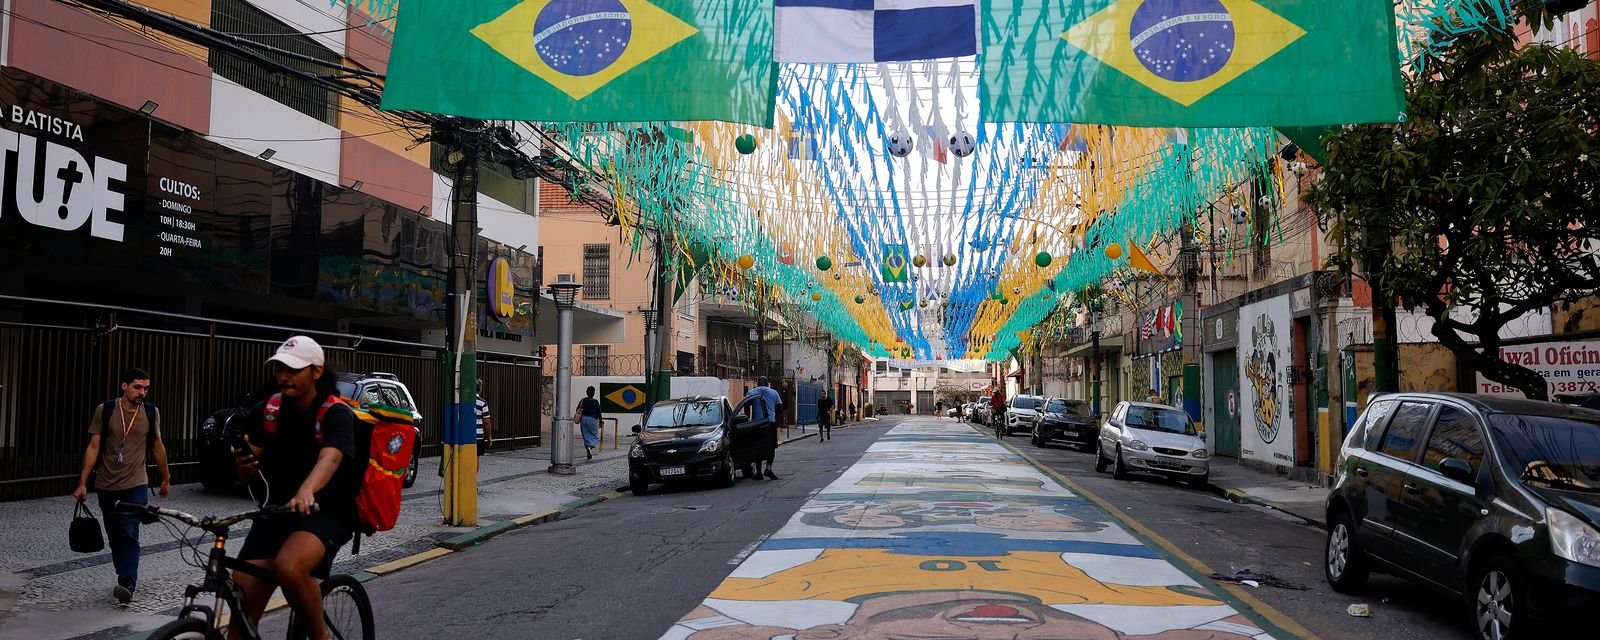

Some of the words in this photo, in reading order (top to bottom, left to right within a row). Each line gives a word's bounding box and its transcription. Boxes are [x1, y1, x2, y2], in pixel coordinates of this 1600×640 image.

[12, 104, 84, 142] BATISTA
[159, 177, 201, 201] CULTOS:
[162, 199, 192, 214] DOMINGO
[160, 231, 202, 249] QUARTA-FEIRA
[159, 246, 172, 256] 20H
[1554, 369, 1571, 377] em
